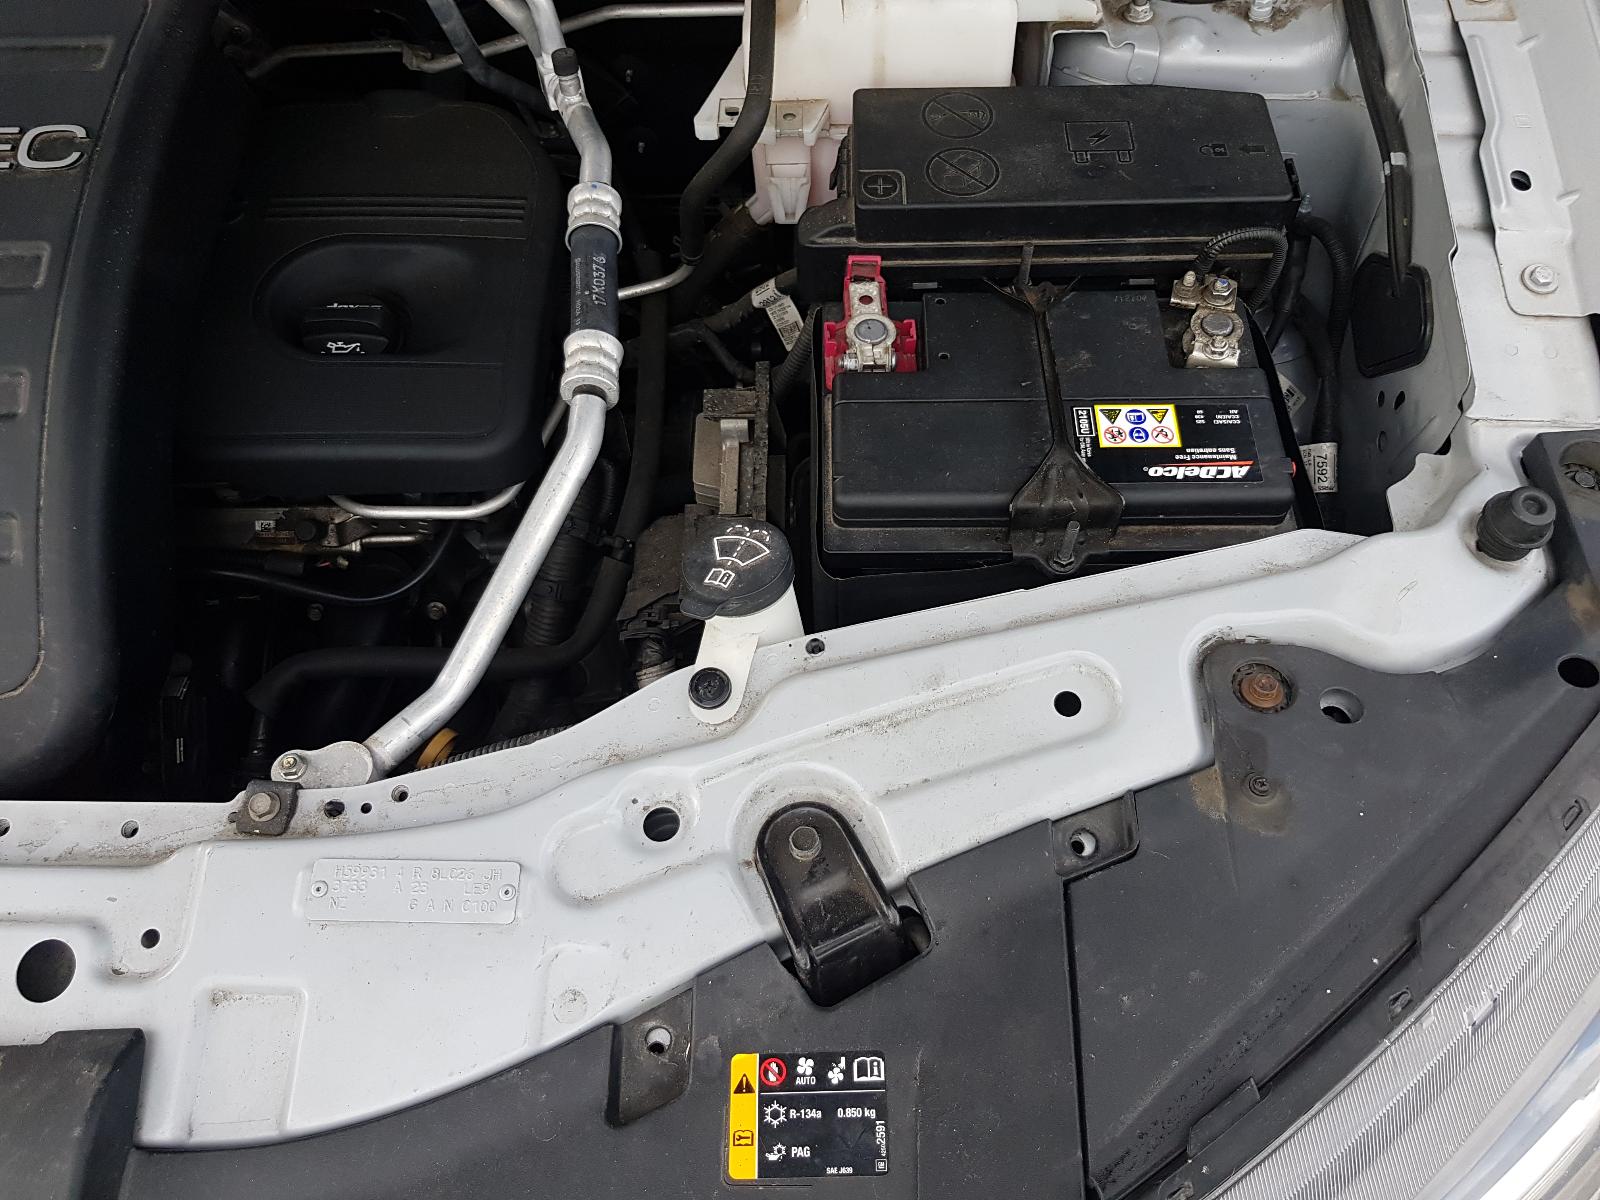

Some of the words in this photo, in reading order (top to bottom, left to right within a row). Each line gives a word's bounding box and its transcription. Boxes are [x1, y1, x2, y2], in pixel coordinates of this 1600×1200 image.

[1316, 453, 1328, 484] 7592
[795, 1076, 816, 1085] AUTO
[789, 1109, 822, 1119] R-134a
[837, 1108, 863, 1118] 0.850
[864, 1108, 876, 1119] kg
[791, 1147, 811, 1157] PAG
[838, 1166, 853, 1174] J639
